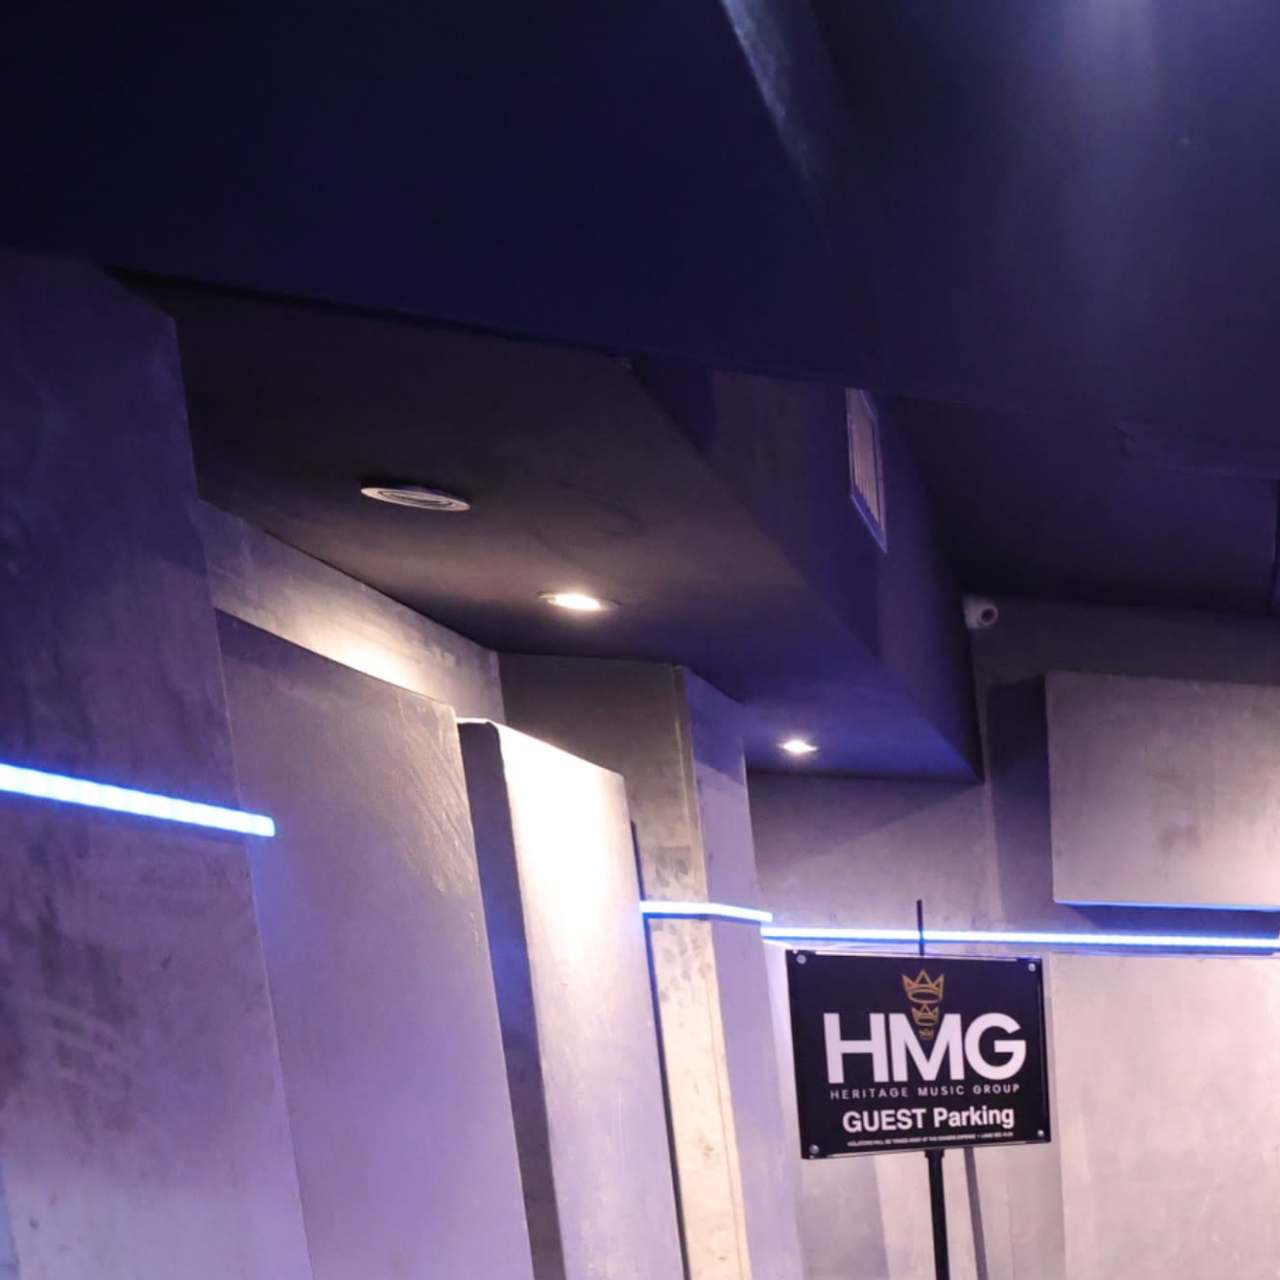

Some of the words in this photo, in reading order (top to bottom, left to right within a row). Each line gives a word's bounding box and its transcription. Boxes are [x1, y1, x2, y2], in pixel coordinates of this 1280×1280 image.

[823, 1012, 1026, 1084] HMG
[830, 1087, 908, 1100] HERITAGE
[918, 1085, 965, 1096] MUSIC
[973, 1083, 1020, 1094] GROUP
[843, 1108, 926, 1132] GUEST
[933, 1105, 1015, 1129] Parking
